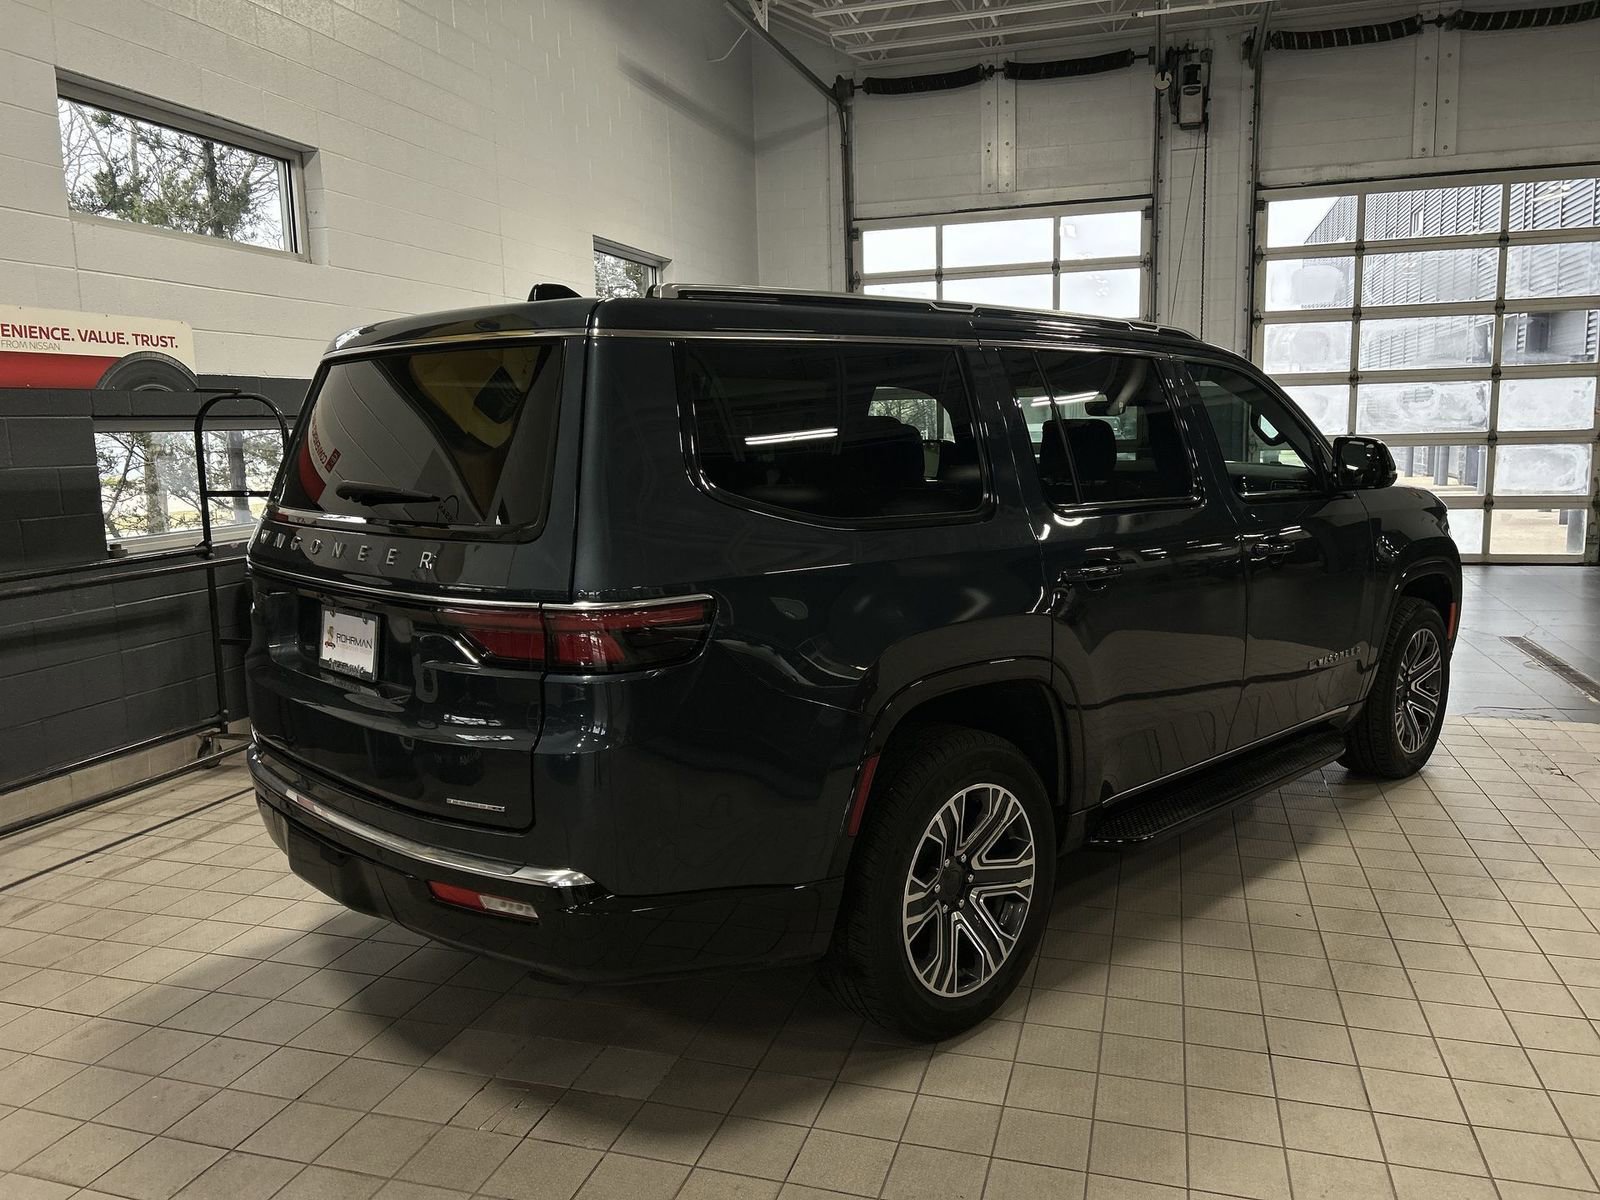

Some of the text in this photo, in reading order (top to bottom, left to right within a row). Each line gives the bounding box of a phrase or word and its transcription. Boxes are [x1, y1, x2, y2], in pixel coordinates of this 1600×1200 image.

[1, 340, 61, 351] FROM NISSAN
[77, 329, 129, 345] VALUE.
[132, 333, 178, 349] TRUST.
[335, 632, 373, 649] ROHRMAN
